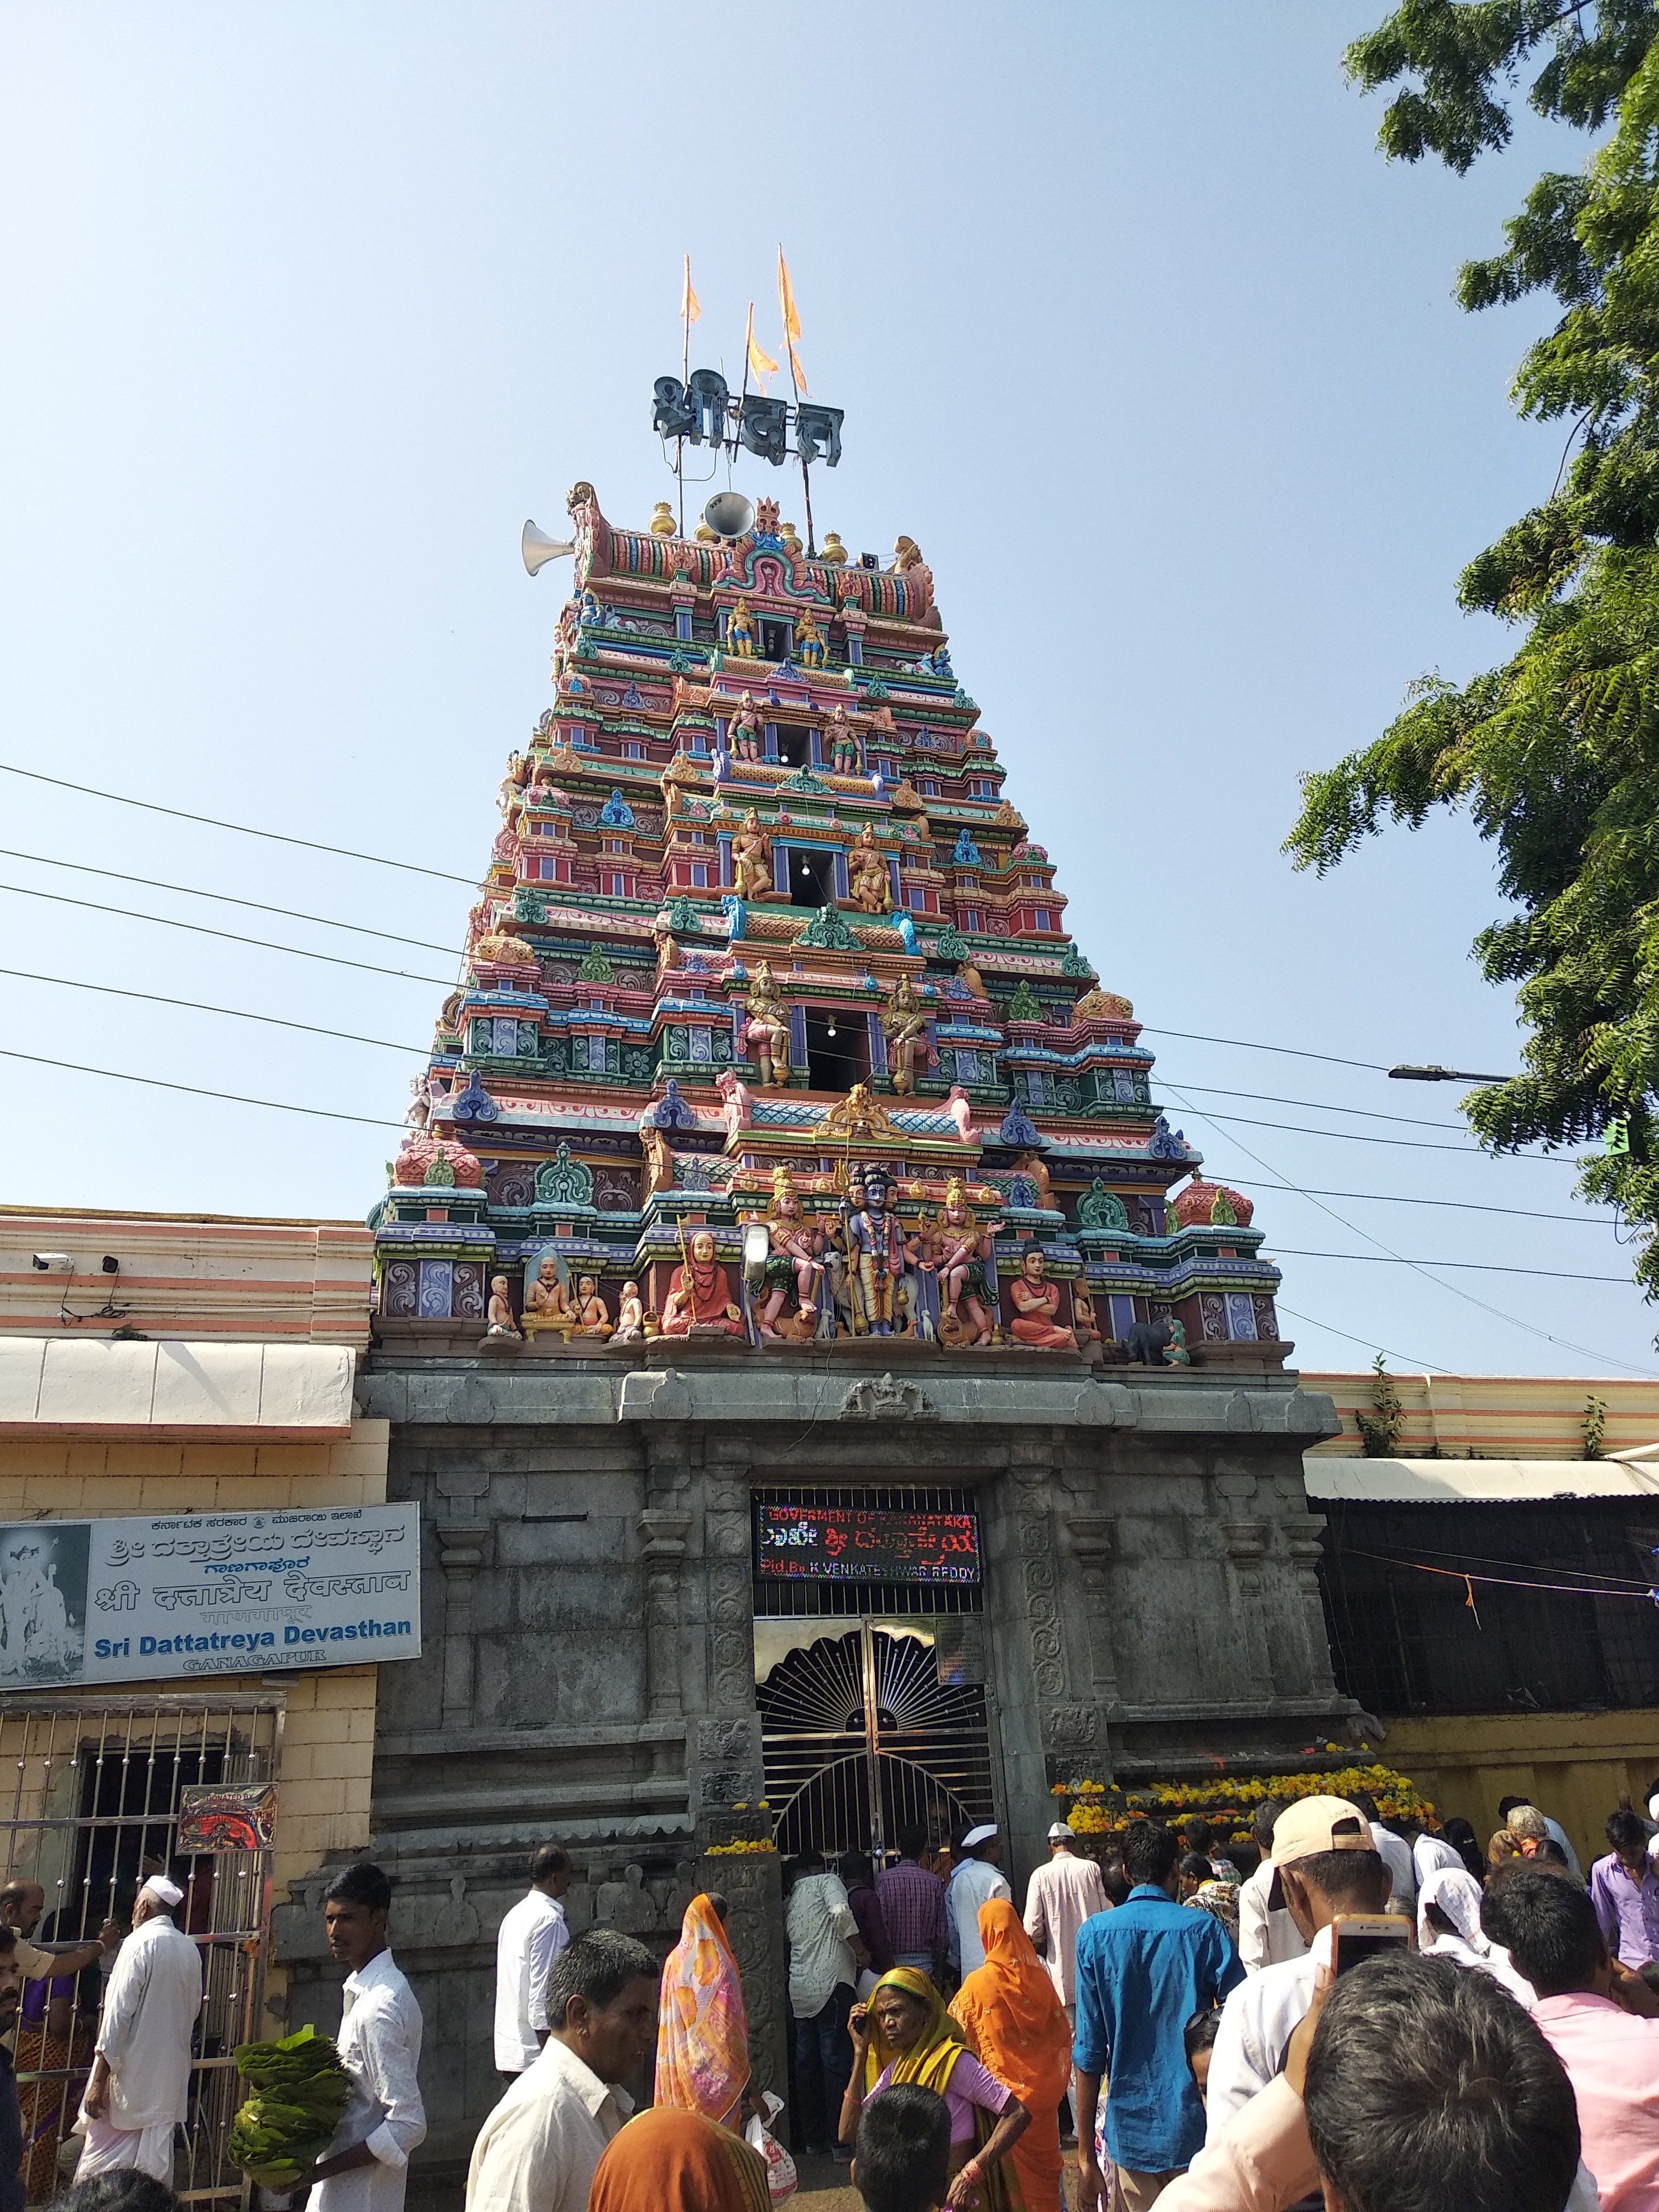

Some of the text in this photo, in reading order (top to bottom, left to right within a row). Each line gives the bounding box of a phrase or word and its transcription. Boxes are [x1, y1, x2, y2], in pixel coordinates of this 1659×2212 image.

[650, 369, 729, 448] श्री
[151, 1509, 362, 1530] ಕರ್ನಾಟಕ ಸರಕಾರ ಮುಜರಾಯಿ ಇಲಾಖೆ
[105, 1539, 144, 1567] ಶ್ರೀ
[94, 1570, 411, 1611] श्री दत्तात्रेय देवस्तान
[94, 1619, 411, 1659] Sri Dattatreya Devasthan
[183, 1650, 326, 1671] GANAGAPUR
